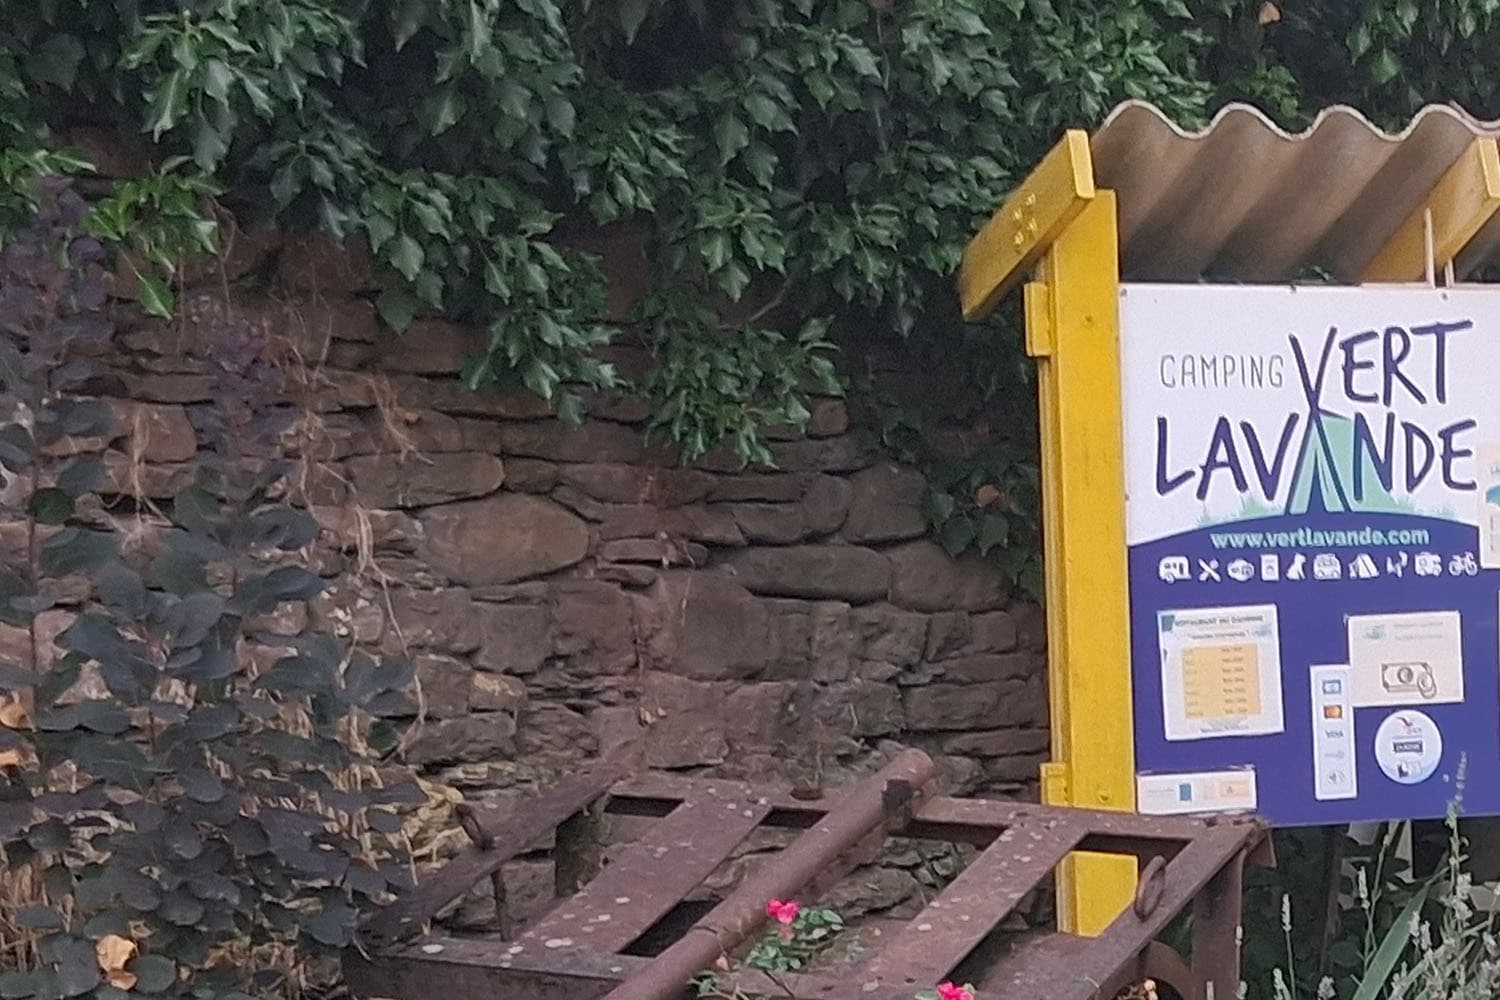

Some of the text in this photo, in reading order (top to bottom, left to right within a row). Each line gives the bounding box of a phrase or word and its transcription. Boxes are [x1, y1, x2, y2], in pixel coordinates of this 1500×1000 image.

[1159, 319, 1474, 408] CAMPING VERT
[1156, 408, 1477, 515] LAVANDE
[1209, 527, 1430, 549] www.vertlavande.com
